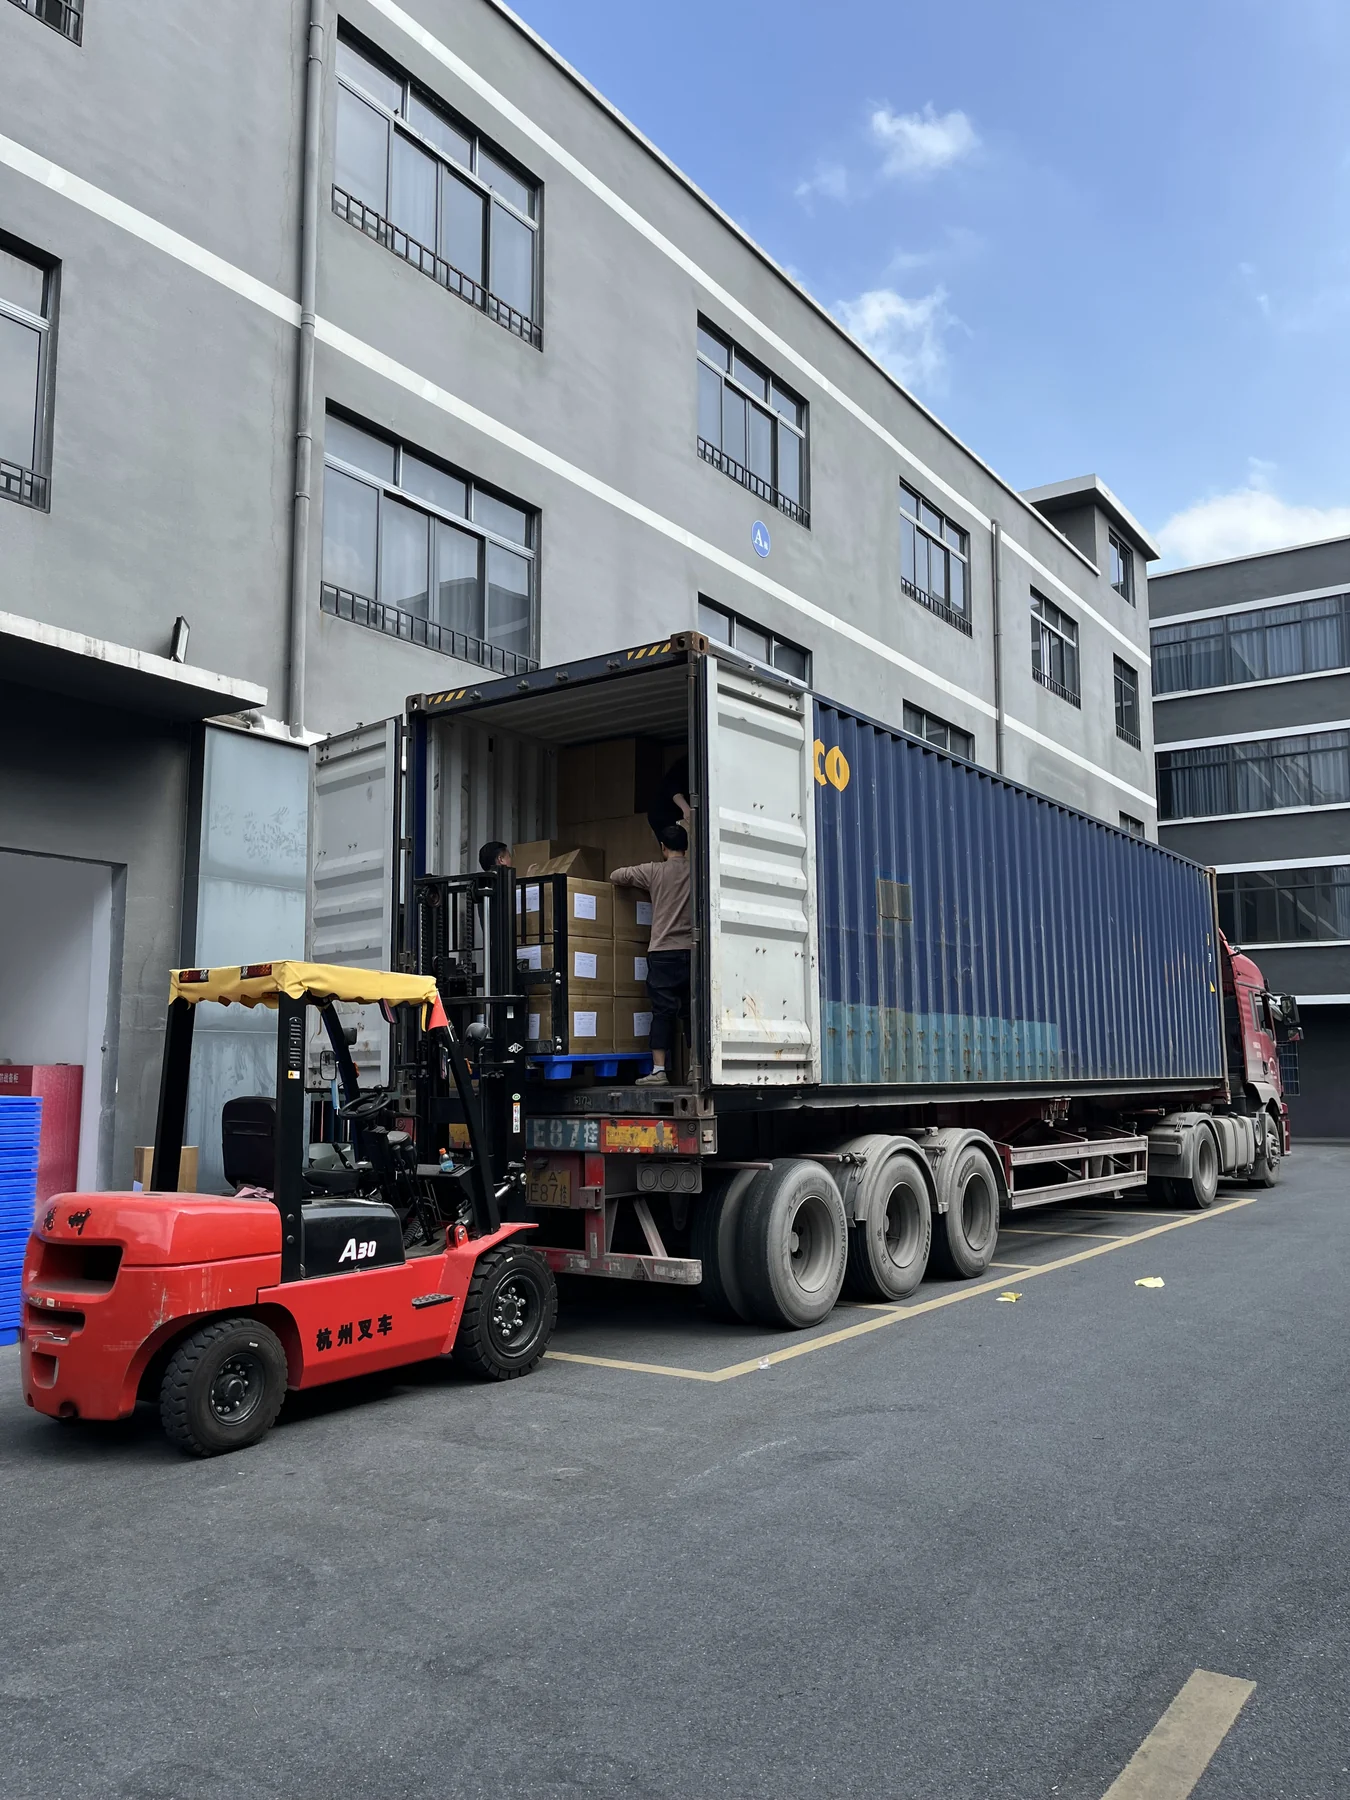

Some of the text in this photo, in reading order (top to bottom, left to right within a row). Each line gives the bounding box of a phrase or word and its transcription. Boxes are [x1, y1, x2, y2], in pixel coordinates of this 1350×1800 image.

[527, 1183, 568, 1205] E87挂
[338, 1238, 377, 1263] A30
[316, 1314, 393, 1352] 杭州叉车
